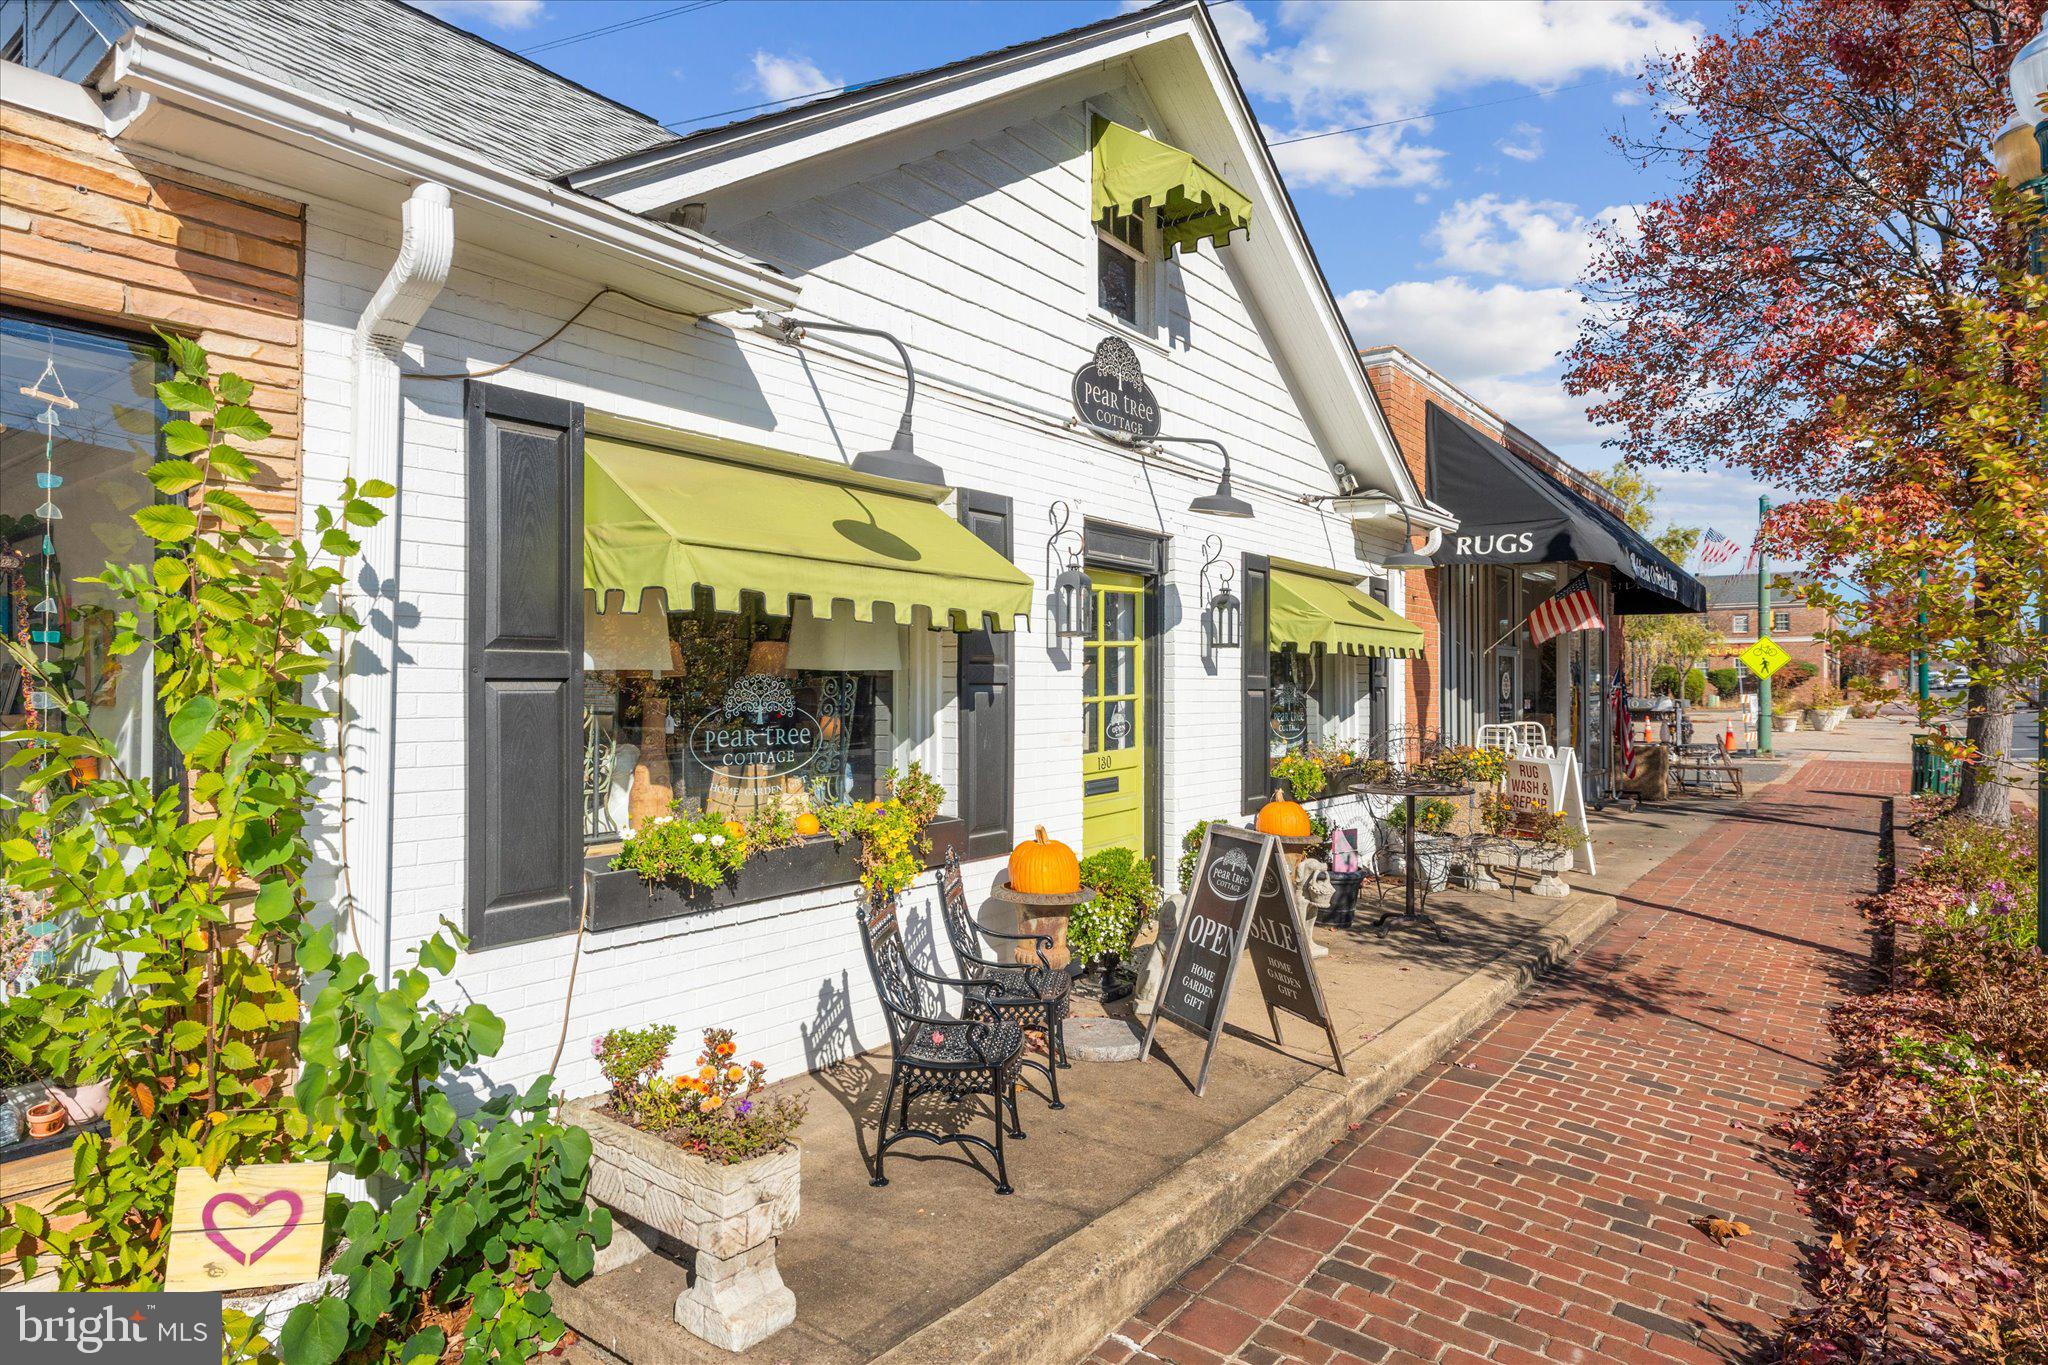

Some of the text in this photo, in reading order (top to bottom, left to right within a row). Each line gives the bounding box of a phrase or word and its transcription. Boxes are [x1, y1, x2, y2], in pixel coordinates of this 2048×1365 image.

[1096, 409, 1144, 435] COTTAGE
[1456, 532, 1534, 556] RUGS
[722, 750, 795, 766] COTTAGE
[1097, 755, 1112, 771] 130
[1519, 764, 1539, 779] RUG
[709, 782, 740, 796] HOME
[744, 784, 783, 797] GARDEN
[1511, 779, 1549, 796] WASH &
[1216, 879, 1241, 893] COTTAGE
[1188, 914, 1240, 959] OPEN
[1250, 915, 1298, 954] SALE
[1190, 962, 1216, 983] HOME
[1267, 956, 1293, 974] HOME
[1182, 975, 1216, 999] GARDEN
[1267, 968, 1302, 989] GARDEN
[1277, 984, 1298, 1001] GIFT
[1184, 993, 1205, 1011] GIFT
